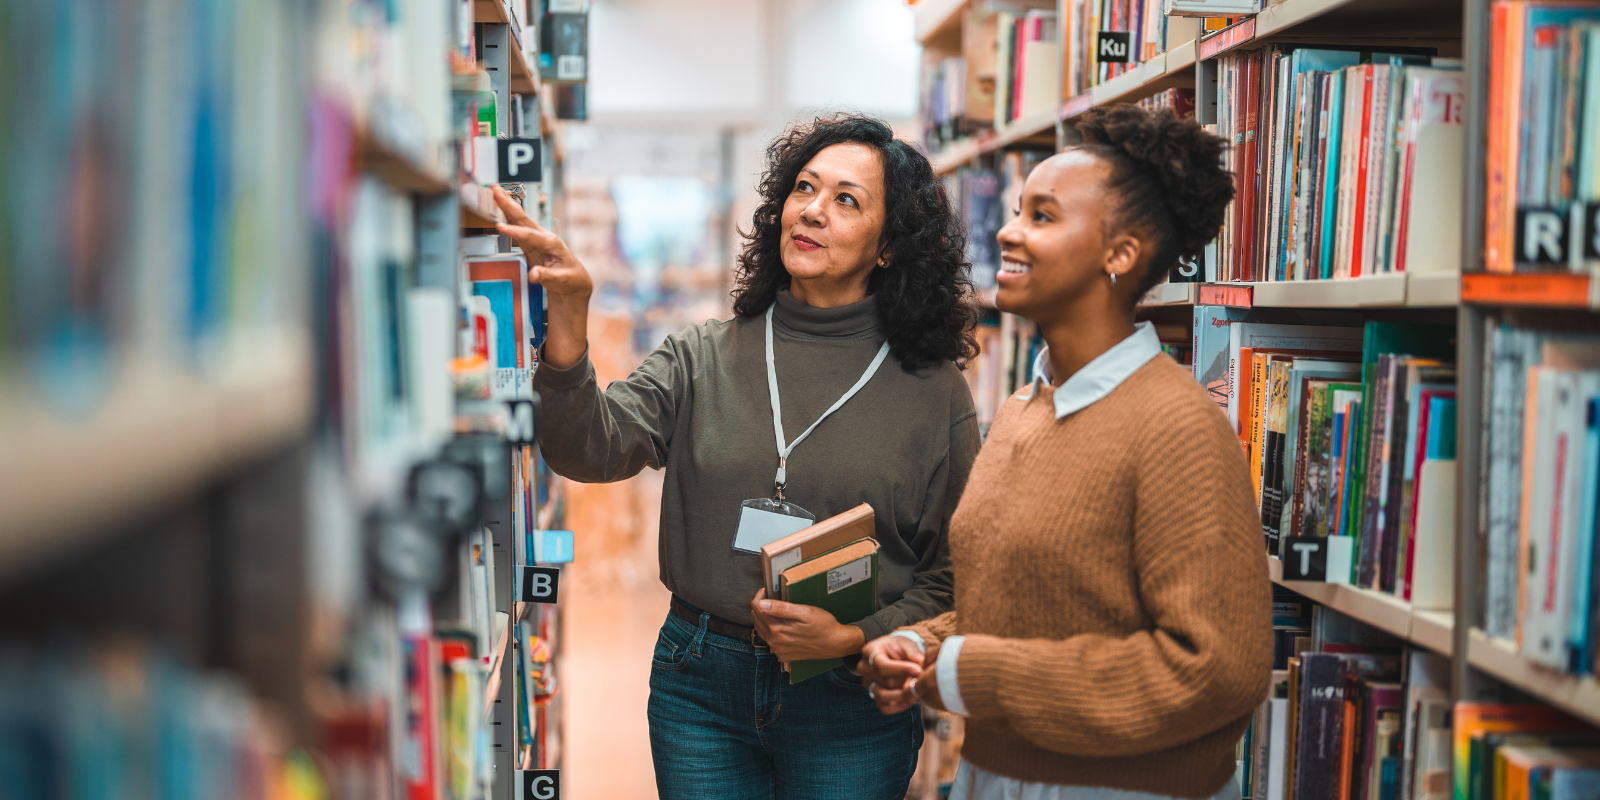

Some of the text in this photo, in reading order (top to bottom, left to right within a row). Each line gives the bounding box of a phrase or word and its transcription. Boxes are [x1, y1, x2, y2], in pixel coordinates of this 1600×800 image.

[1100, 38, 1127, 57] Ku
[507, 142, 535, 177] P
[1524, 211, 1563, 263] R
[1178, 254, 1198, 277] S
[503, 402, 534, 442] M
[1292, 542, 1320, 577] T
[531, 573, 552, 597] B
[531, 776, 555, 800] G
